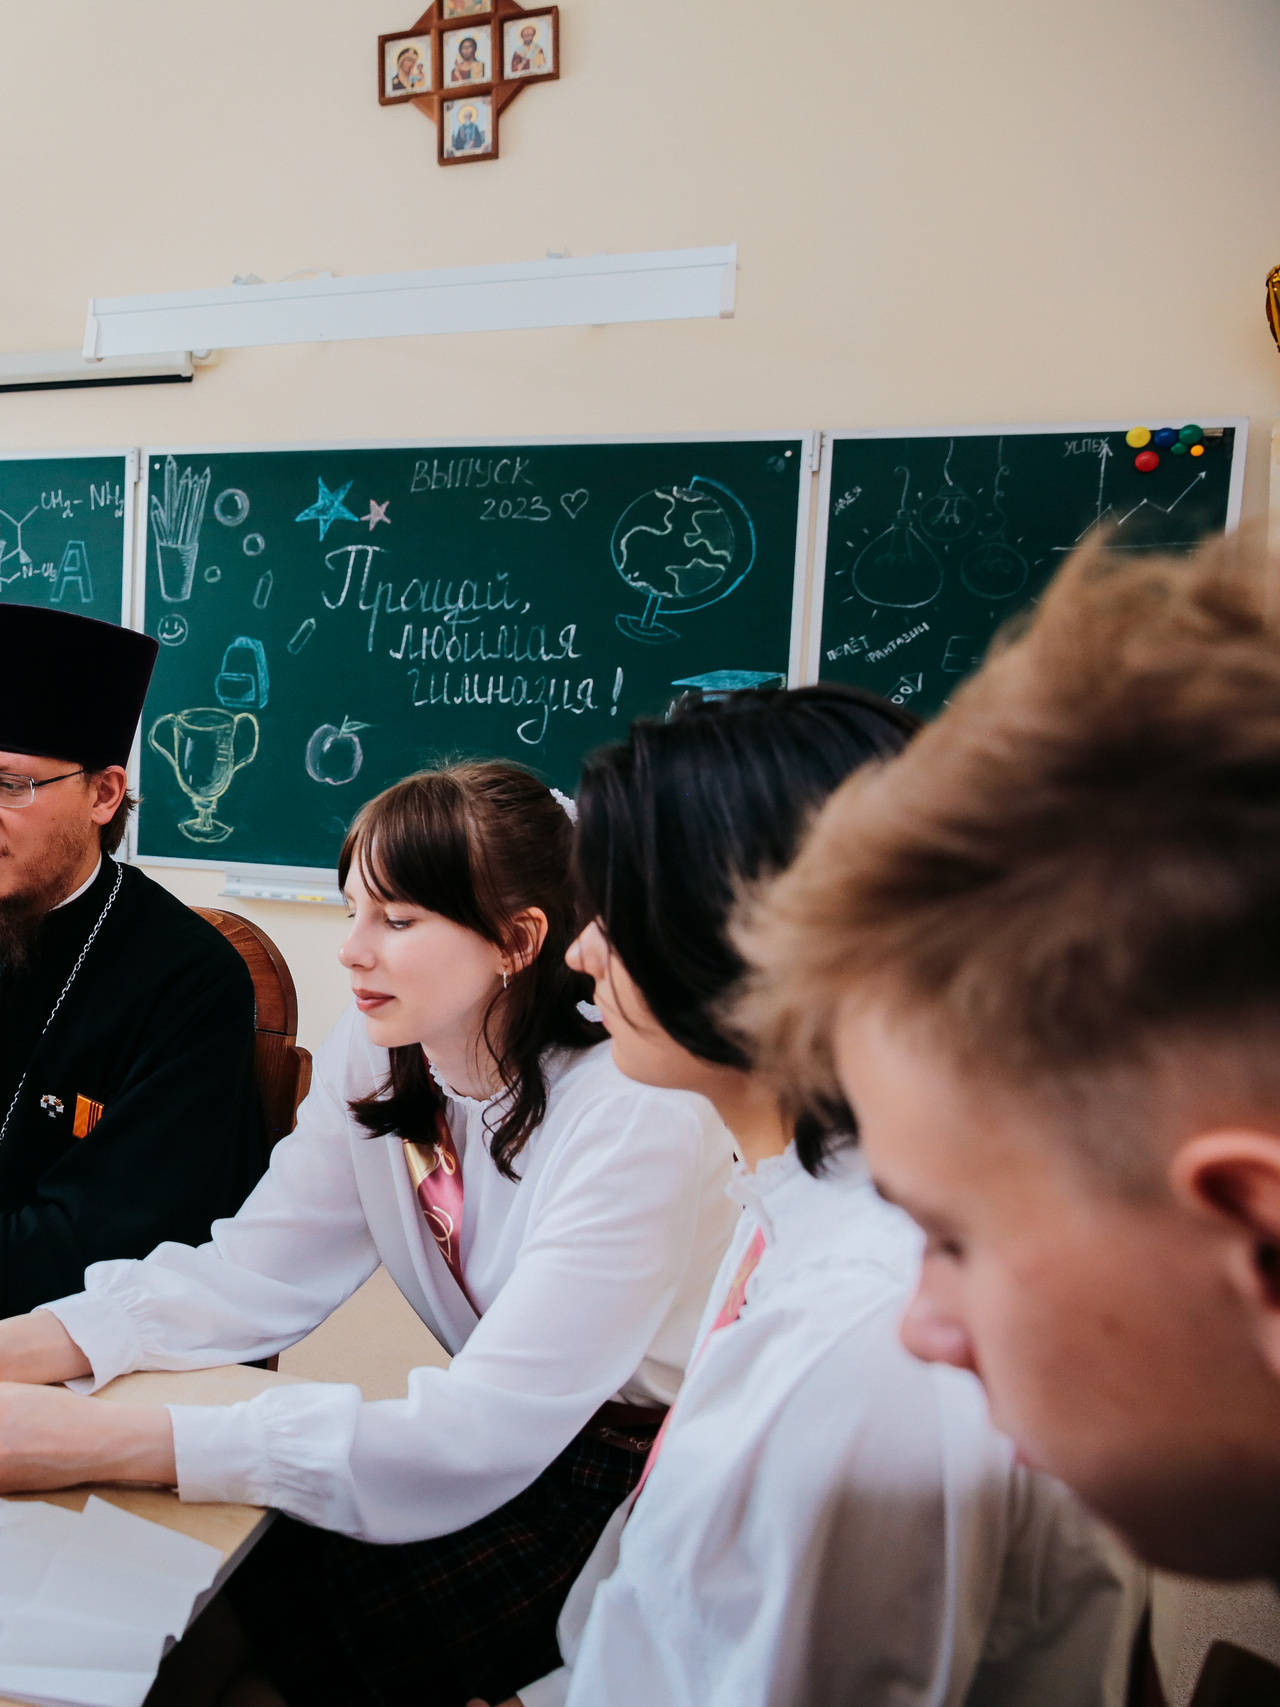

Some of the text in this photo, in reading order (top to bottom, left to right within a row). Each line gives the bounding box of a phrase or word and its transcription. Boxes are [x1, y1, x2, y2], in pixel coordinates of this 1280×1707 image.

[410, 456, 534, 493] ВЫПУСК
[479, 495, 552, 521] 2023
[322, 544, 530, 652] Прощай,
[389, 612, 583, 663] любимая
